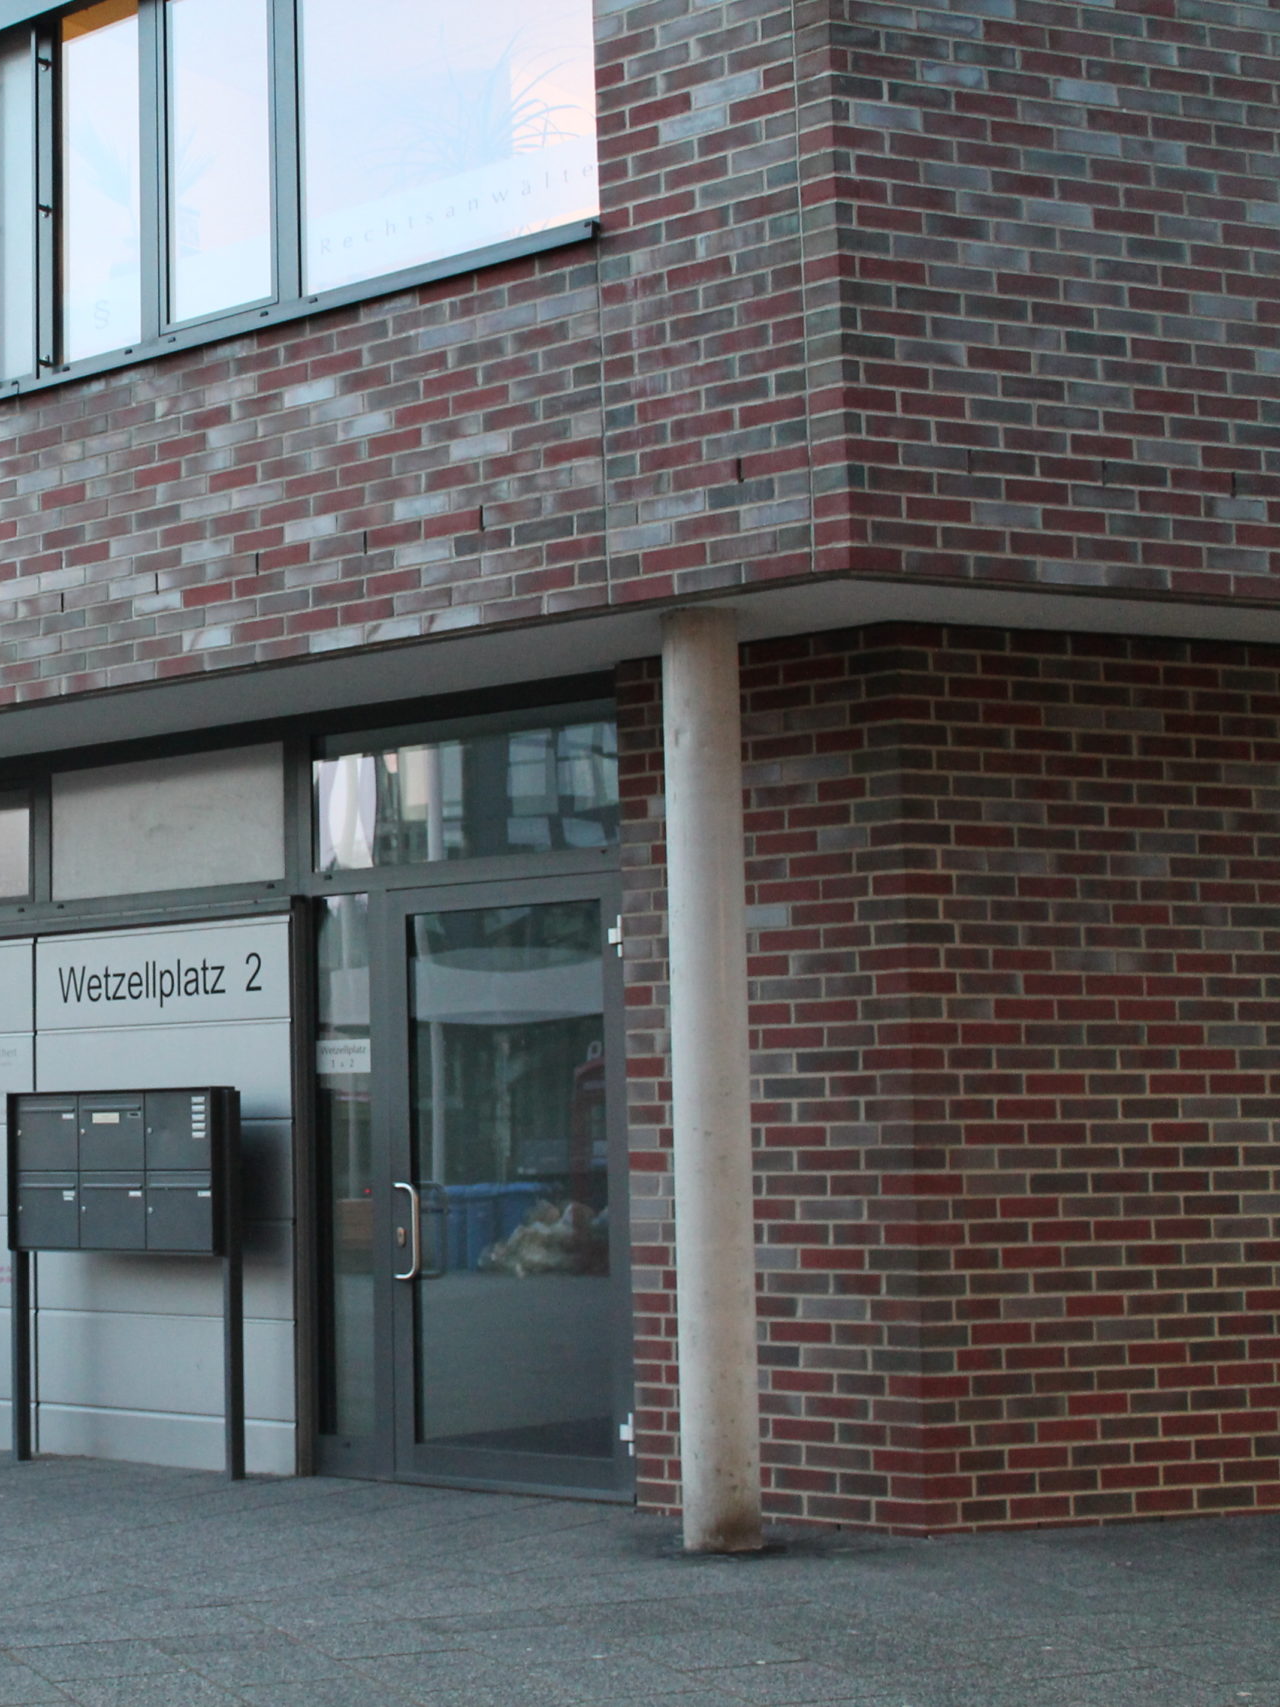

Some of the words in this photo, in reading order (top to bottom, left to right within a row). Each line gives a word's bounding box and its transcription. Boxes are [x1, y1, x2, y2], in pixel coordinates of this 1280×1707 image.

[319, 162, 595, 256] Rechtsanwälte
[58, 956, 227, 1008] Wetzellplatz
[244, 952, 263, 993] 2
